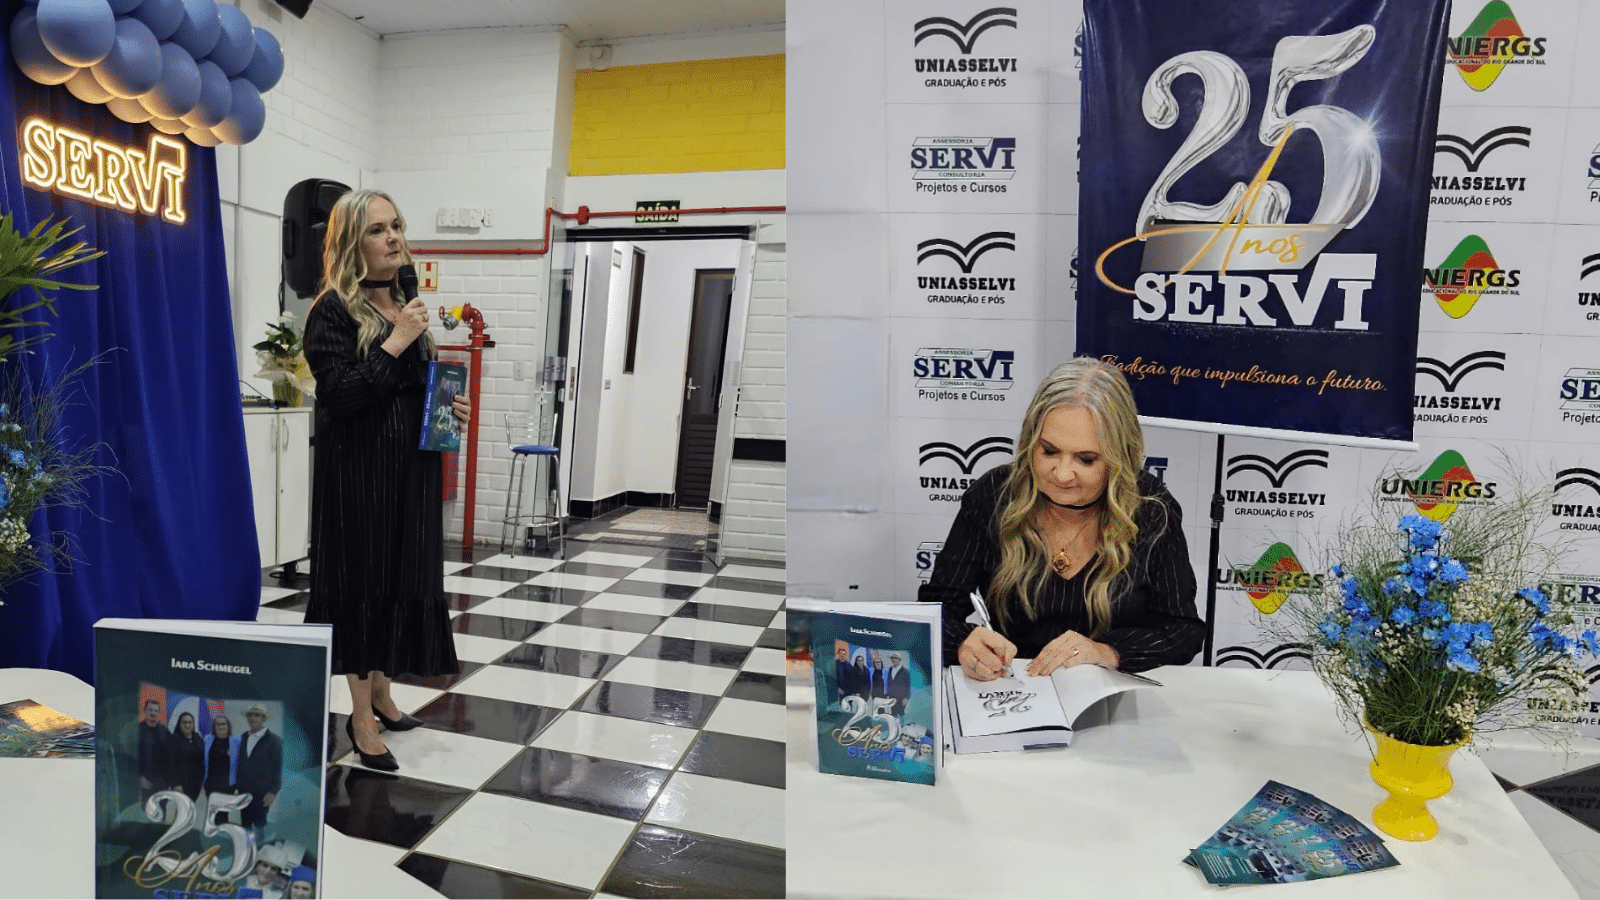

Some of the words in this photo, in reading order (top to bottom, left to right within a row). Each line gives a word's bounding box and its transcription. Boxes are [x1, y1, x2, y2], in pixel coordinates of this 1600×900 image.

[1447, 37, 1547, 56] NIERGS
[914, 58, 1017, 73] UNIASSELVI
[925, 77, 979, 89] GRADUAÇÃO
[981, 79, 986, 87] E
[989, 77, 1006, 87] PÓS
[1137, 24, 1381, 241] 25
[910, 137, 1016, 169] SERVI
[23, 118, 187, 223] SERVI
[916, 181, 958, 195] Projetos
[961, 185, 967, 193] e
[970, 181, 1007, 193] Cursos
[1431, 176, 1526, 191] NIASSELVI
[1095, 125, 1329, 293] Anos
[1430, 195, 1482, 207] RADUAÇÃO
[1485, 197, 1490, 205] E
[1493, 196, 1512, 206] PÓS
[917, 276, 1016, 291] UNIASSELVI
[1423, 268, 1520, 287] NIERGS
[927, 294, 979, 305] GRADUAÇÃO
[981, 296, 986, 304] E
[988, 295, 1005, 305] PÓS
[1132, 253, 1377, 331] SERVI
[913, 351, 1014, 380] SERVI
[1170, 364, 1200, 385] que
[1205, 365, 1301, 389] impulsiona
[1306, 376, 1318, 386] o
[1318, 370, 1387, 396] futuro.
[919, 389, 959, 401] Projetos
[970, 390, 1006, 401] Cursos
[1414, 395, 1501, 411] IASSELVI
[1414, 413, 1459, 424] ADUAÇÃO
[1470, 414, 1488, 424] PÓS
[1226, 490, 1325, 505] UNIASSELVI
[1381, 479, 1496, 498] UNIERGS
[1235, 508, 1287, 518] GRADUAÇÃO
[1297, 509, 1314, 518] PÓS
[1217, 568, 1324, 588] UNIERGS
[842, 695, 902, 744] 25
[145, 790, 257, 881] 25
